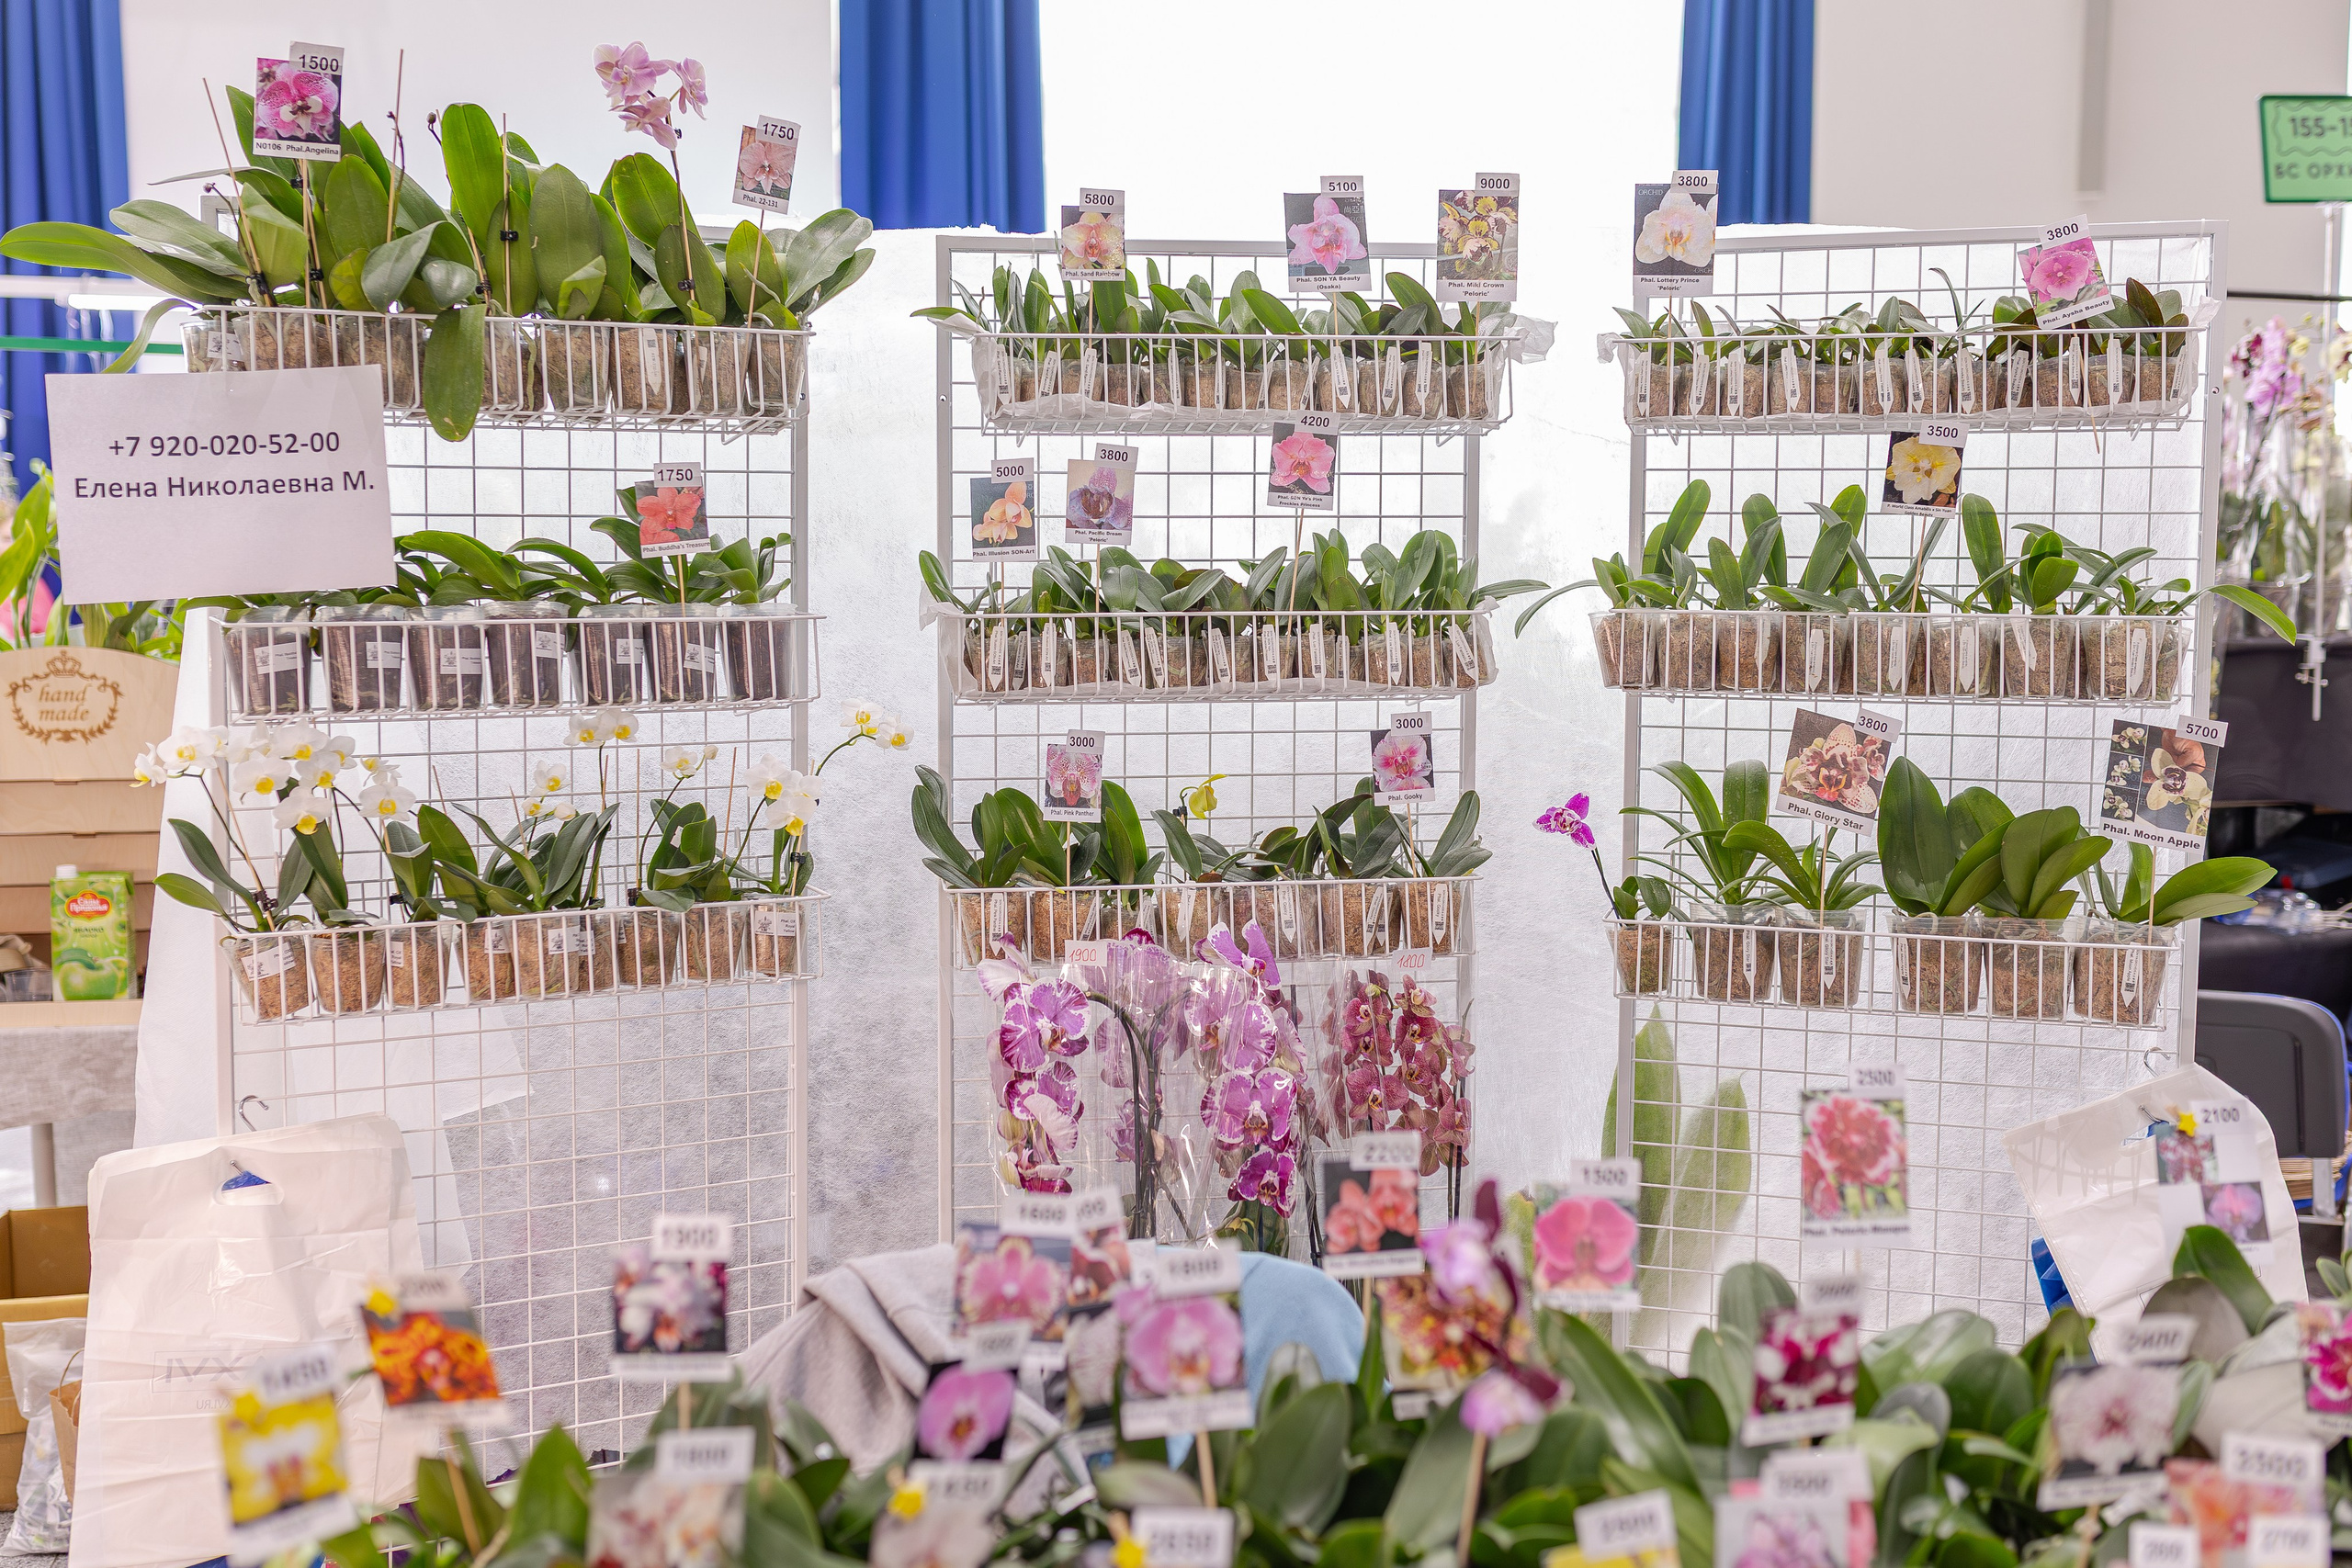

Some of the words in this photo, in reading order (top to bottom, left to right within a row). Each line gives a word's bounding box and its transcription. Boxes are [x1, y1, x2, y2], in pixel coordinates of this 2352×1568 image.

[299, 54, 339, 73] 1500
[763, 122, 795, 141] 1750
[1329, 182, 1358, 192] 5100
[1480, 177, 1510, 189] 9000
[1678, 175, 1708, 187] 3800
[743, 194, 757, 203] Phal.
[759, 197, 778, 208] 22-131
[1084, 193, 1114, 206] 5800
[2046, 222, 2079, 241] 3800
[2042, 317, 2061, 325] Phal.
[2062, 308, 2084, 319] Aysha
[2085, 299, 2109, 310] Beauty
[1300, 415, 1330, 428] 4200
[1927, 425, 1959, 438] 3500
[108, 436, 141, 457] +7
[150, 432, 341, 457] 920-020-52-00
[1100, 448, 1128, 462] 3800
[657, 468, 694, 481] 1750
[996, 465, 1024, 478] 5000
[74, 478, 158, 499] Елена
[167, 476, 334, 497] Николаевна
[343, 470, 375, 491] М.
[686, 541, 711, 549] Treasure
[39, 683, 93, 703] hand
[39, 704, 90, 722] made
[1396, 717, 1423, 729] 3000
[1858, 716, 1888, 733] 3800
[2186, 723, 2219, 739] 5700
[1069, 736, 1095, 748] 3000
[1788, 802, 1811, 816] Phal.
[1815, 810, 1840, 825] Glory
[1842, 818, 1864, 830] Star
[2103, 823, 2131, 836] Phal.
[2133, 829, 2165, 842] Moon
[2167, 836, 2201, 850] Apple
[1069, 948, 1097, 963] 1900
[2201, 1107, 2242, 1124] 2100
[1581, 1167, 1628, 1186] 1500
